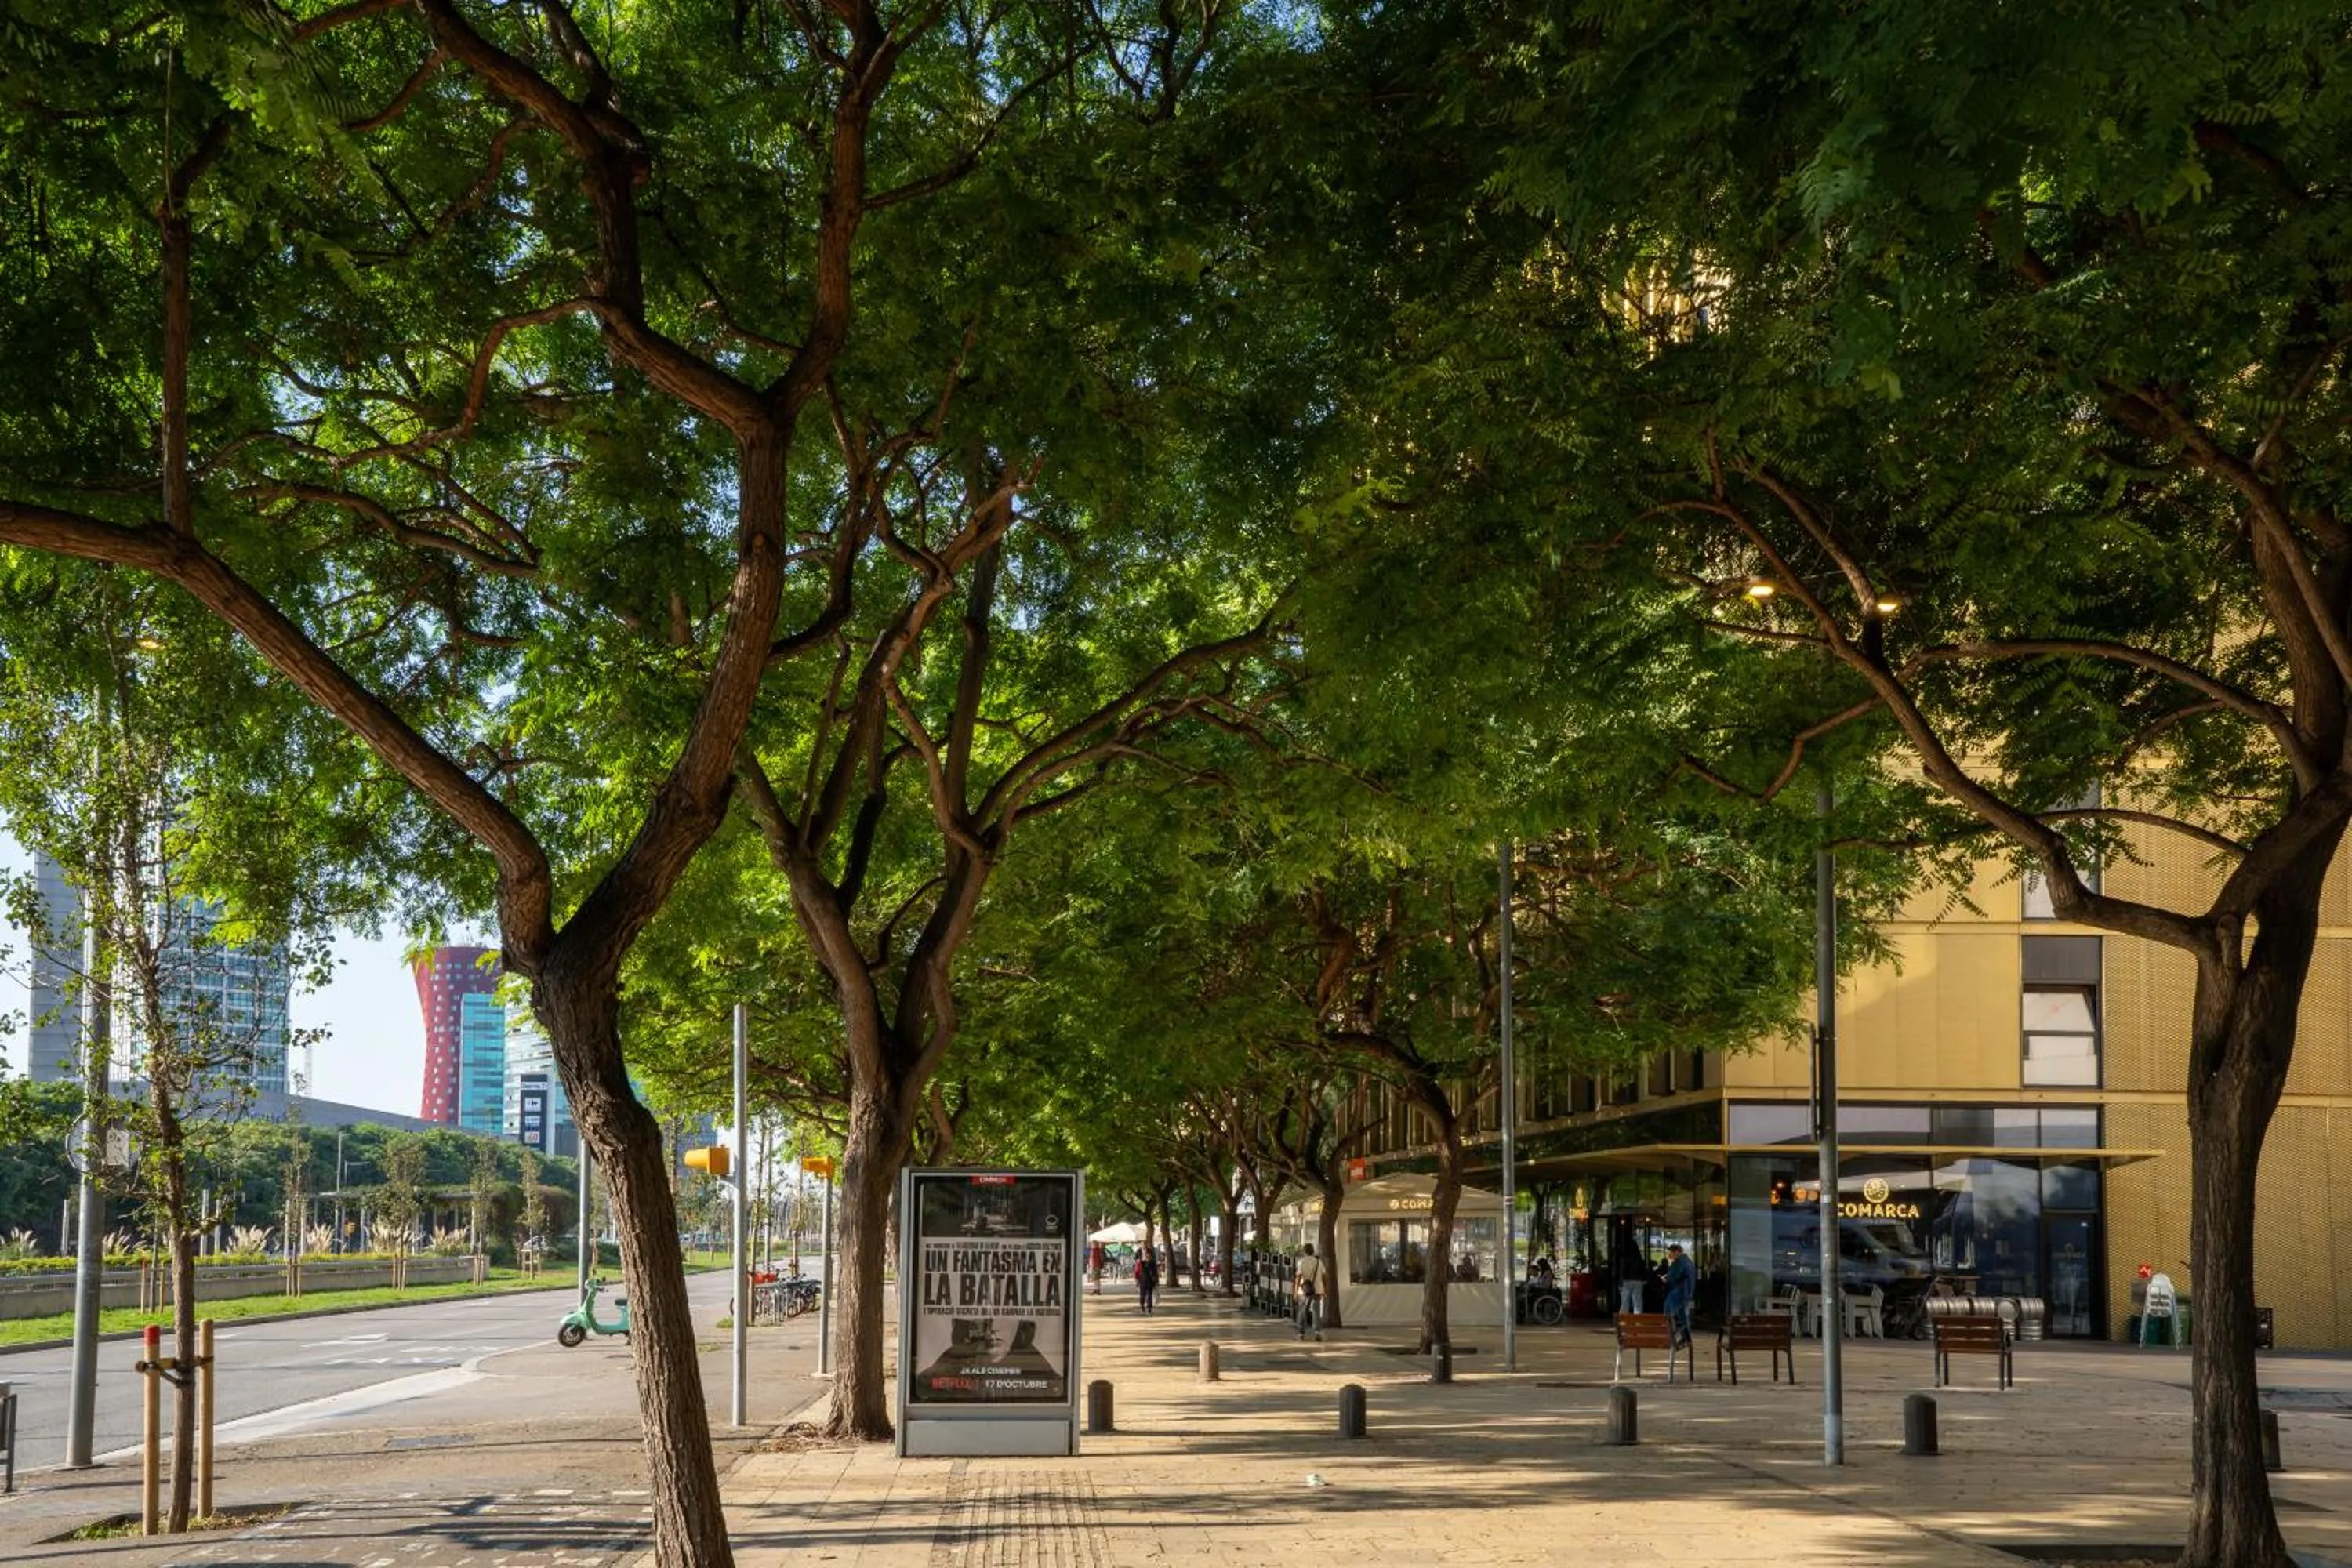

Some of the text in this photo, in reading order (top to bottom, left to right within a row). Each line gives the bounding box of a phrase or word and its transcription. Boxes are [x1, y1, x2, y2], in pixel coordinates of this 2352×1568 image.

[925, 1251, 1061, 1273] UN FANTASMA EN
[924, 1273, 1061, 1306] LA BATALLA
[997, 1379, 1047, 1388] D'OCTUBRE
